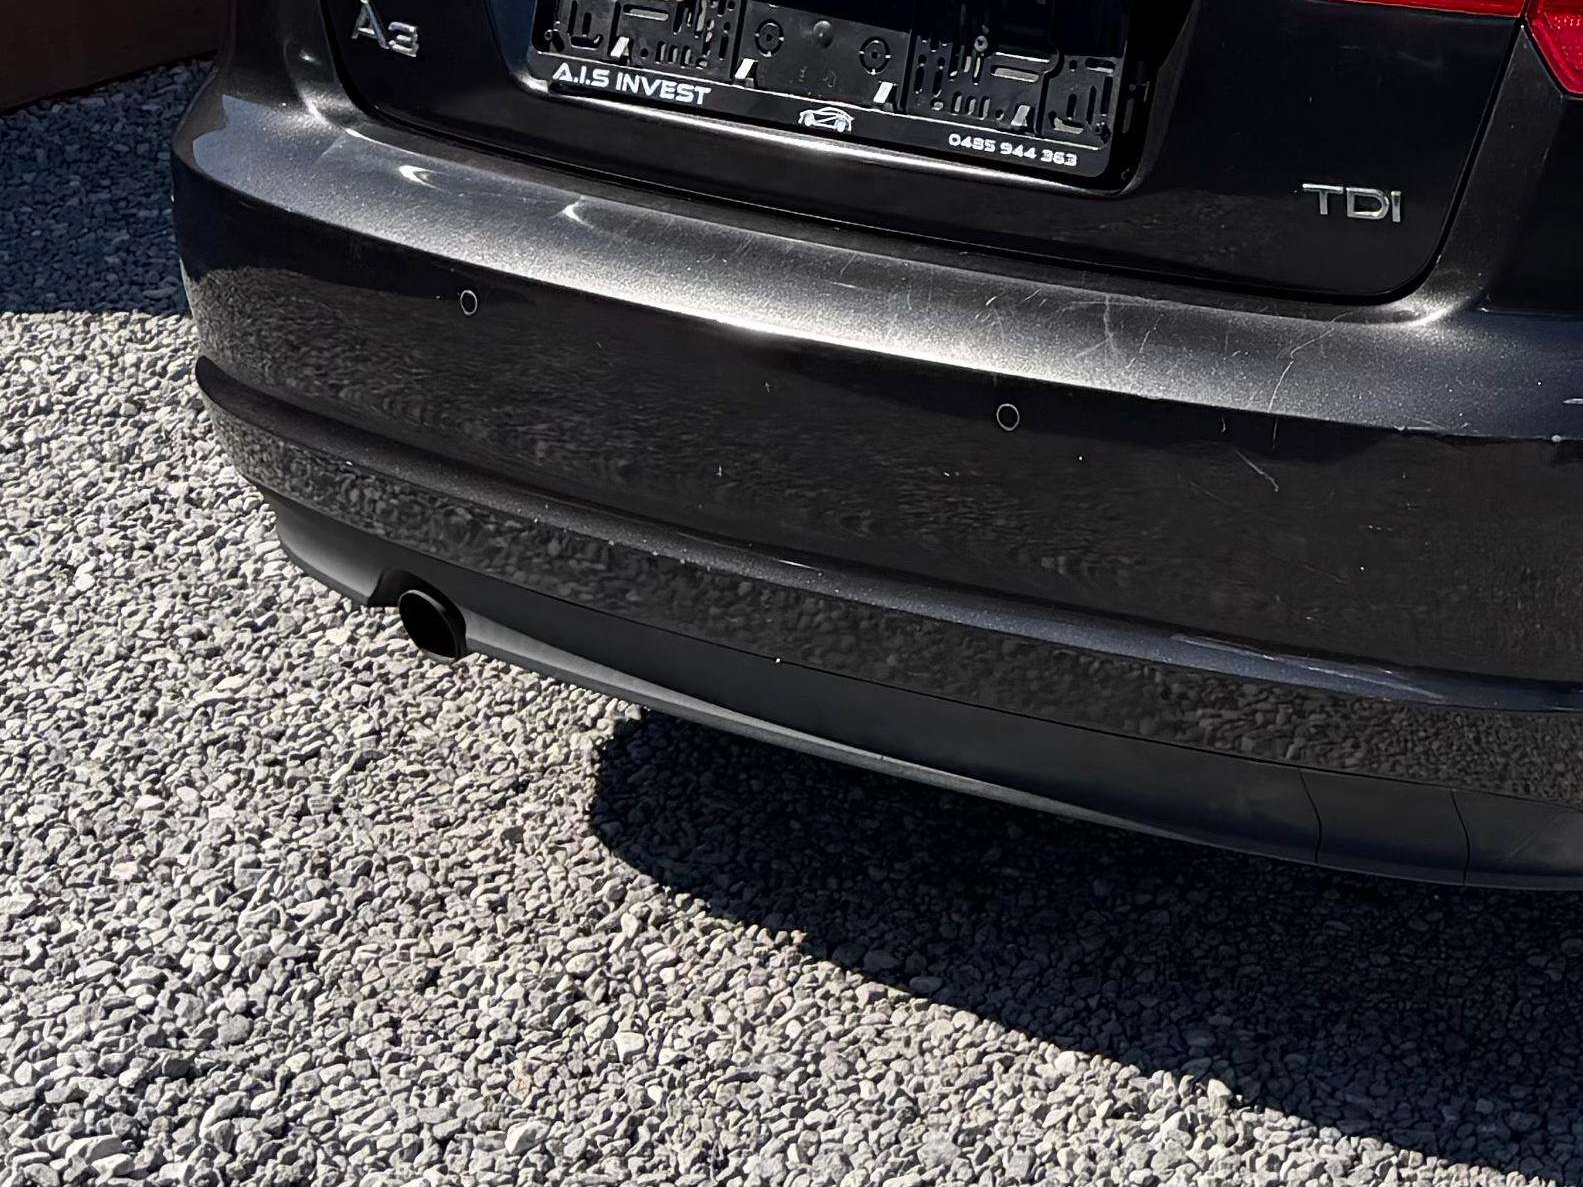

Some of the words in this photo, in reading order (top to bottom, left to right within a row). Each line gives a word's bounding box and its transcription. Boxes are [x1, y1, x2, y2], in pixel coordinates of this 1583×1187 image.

[552, 62, 611, 88] A.I.S
[615, 71, 712, 105] INVEST
[1000, 142, 1038, 160] 944
[1302, 183, 1402, 223] TDI
